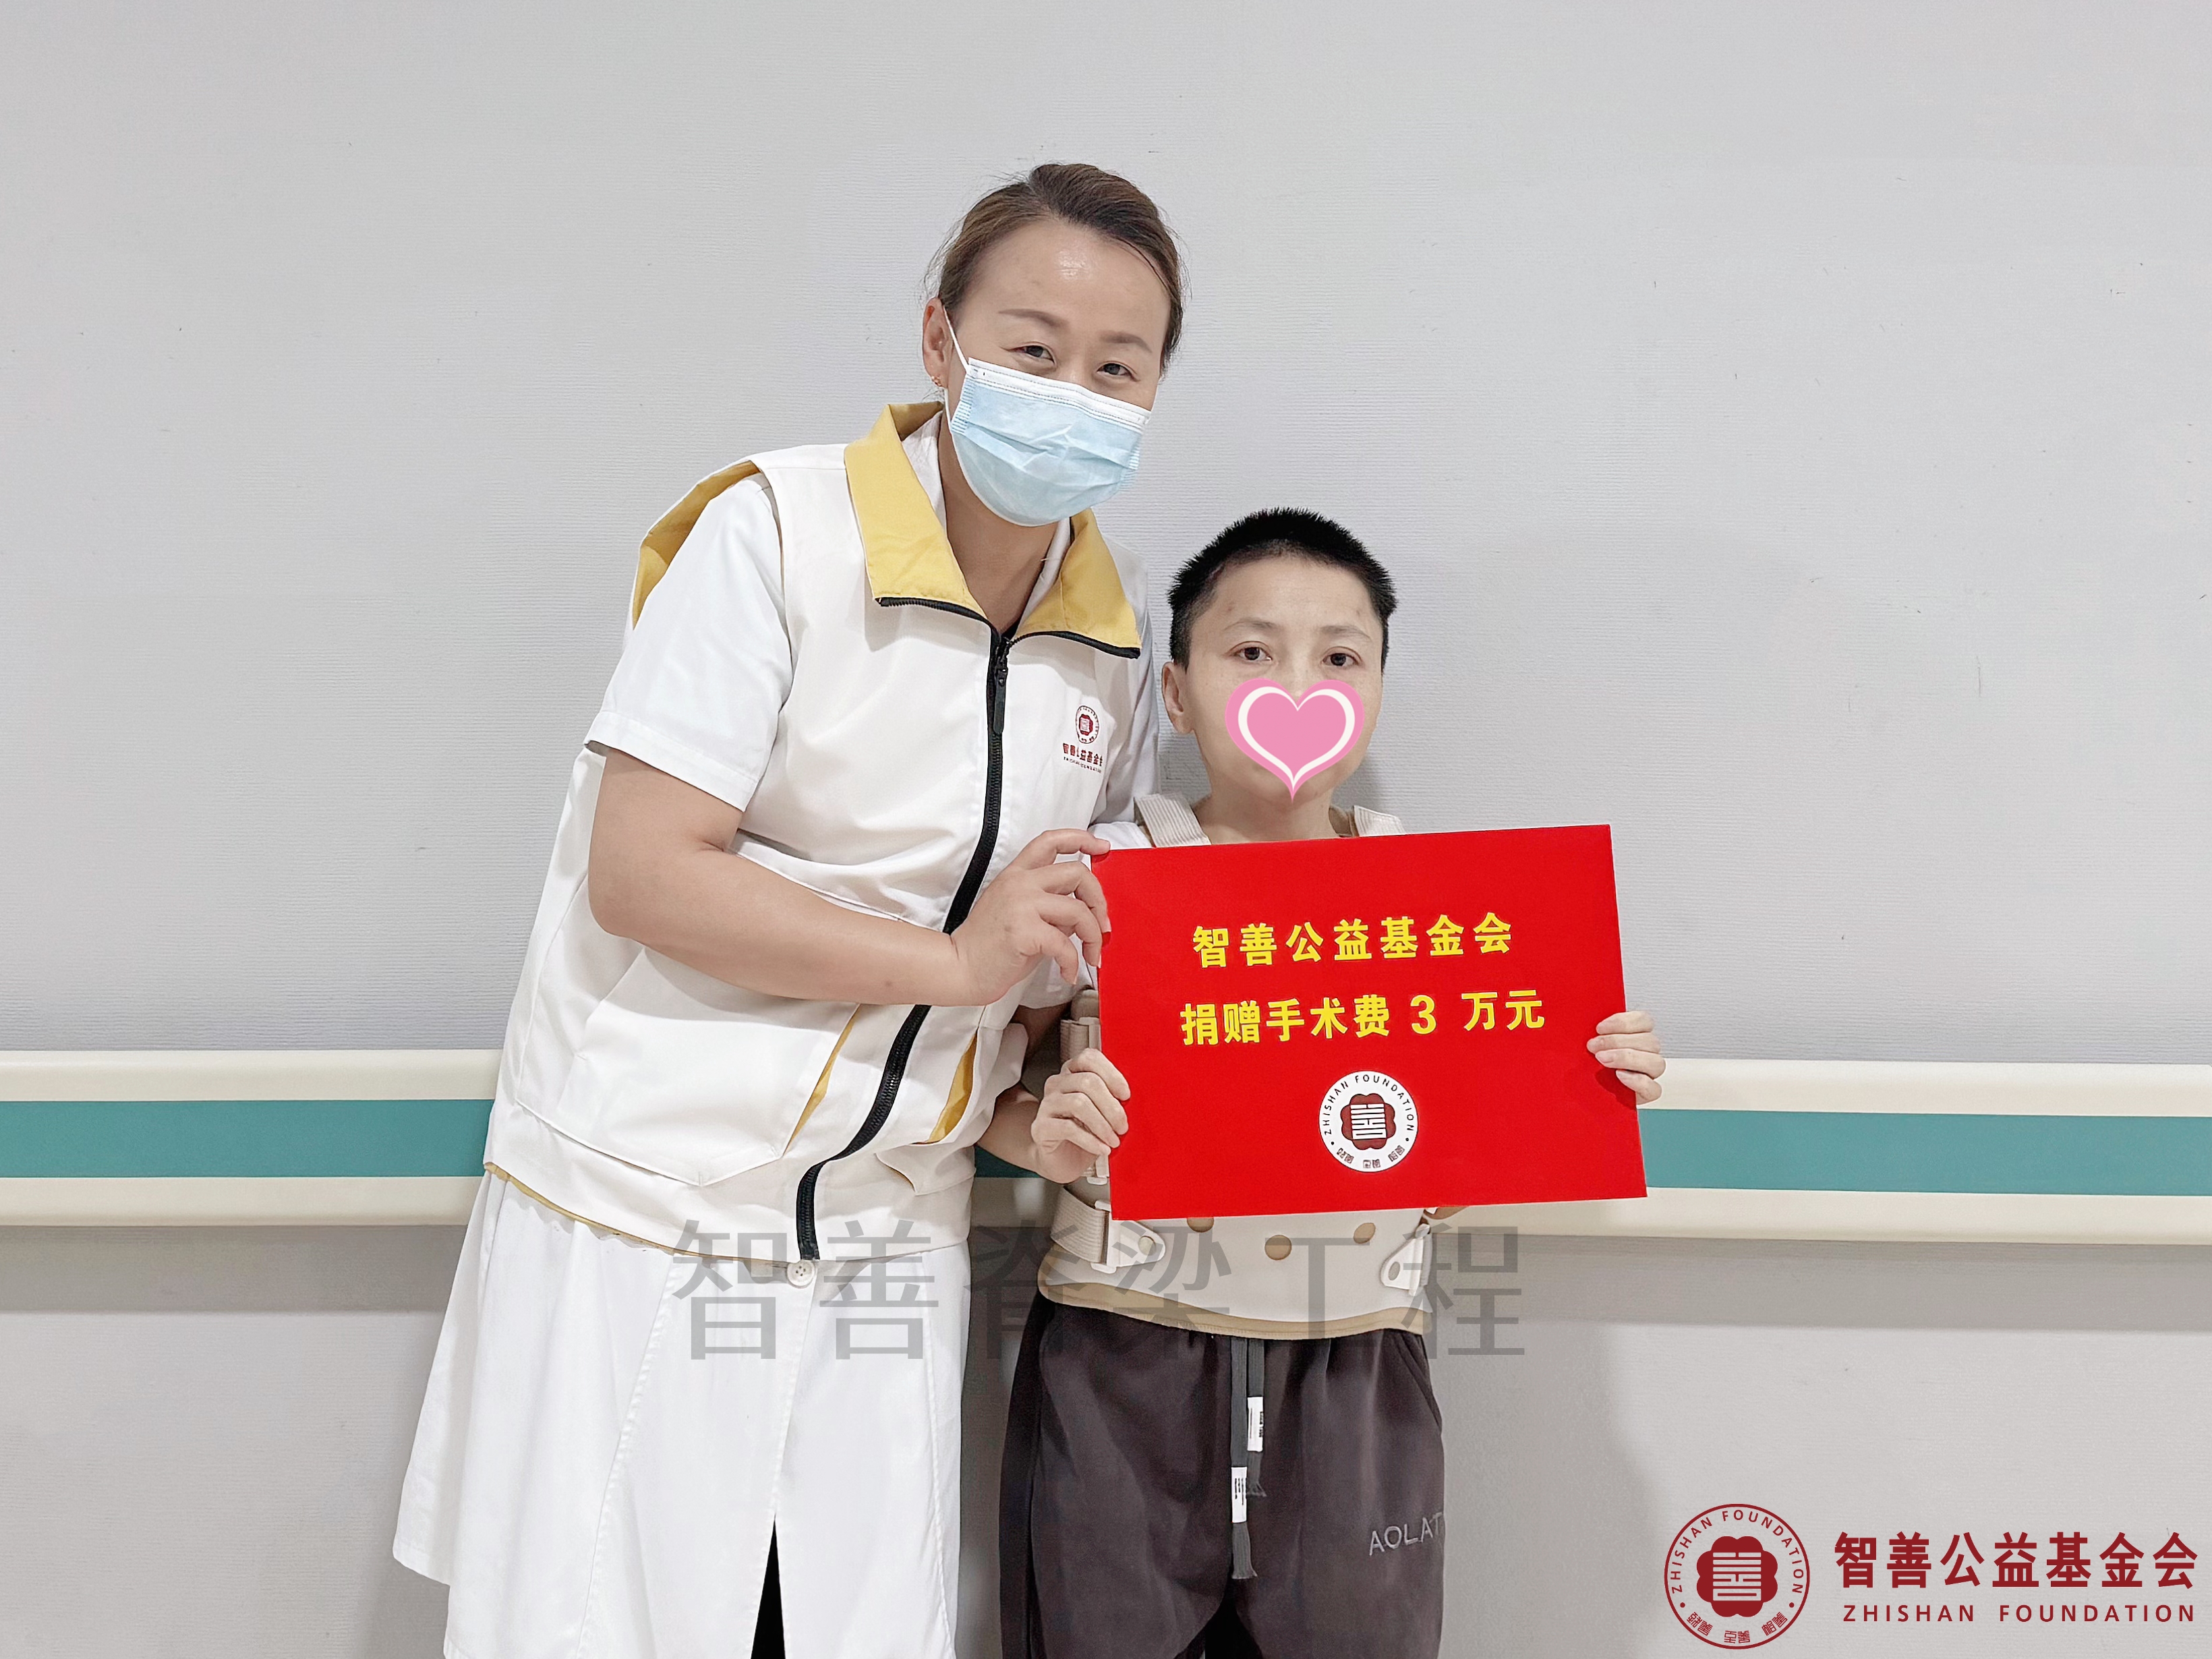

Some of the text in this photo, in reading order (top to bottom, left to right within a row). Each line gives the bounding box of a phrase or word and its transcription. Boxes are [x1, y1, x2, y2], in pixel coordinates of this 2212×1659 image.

[1193, 912, 1511, 968] 智善公益基金会
[1180, 989, 1545, 1045] 捐赠手术费 3 万元
[1322, 1074, 1415, 1136] ZHISHAN FOUNDATION
